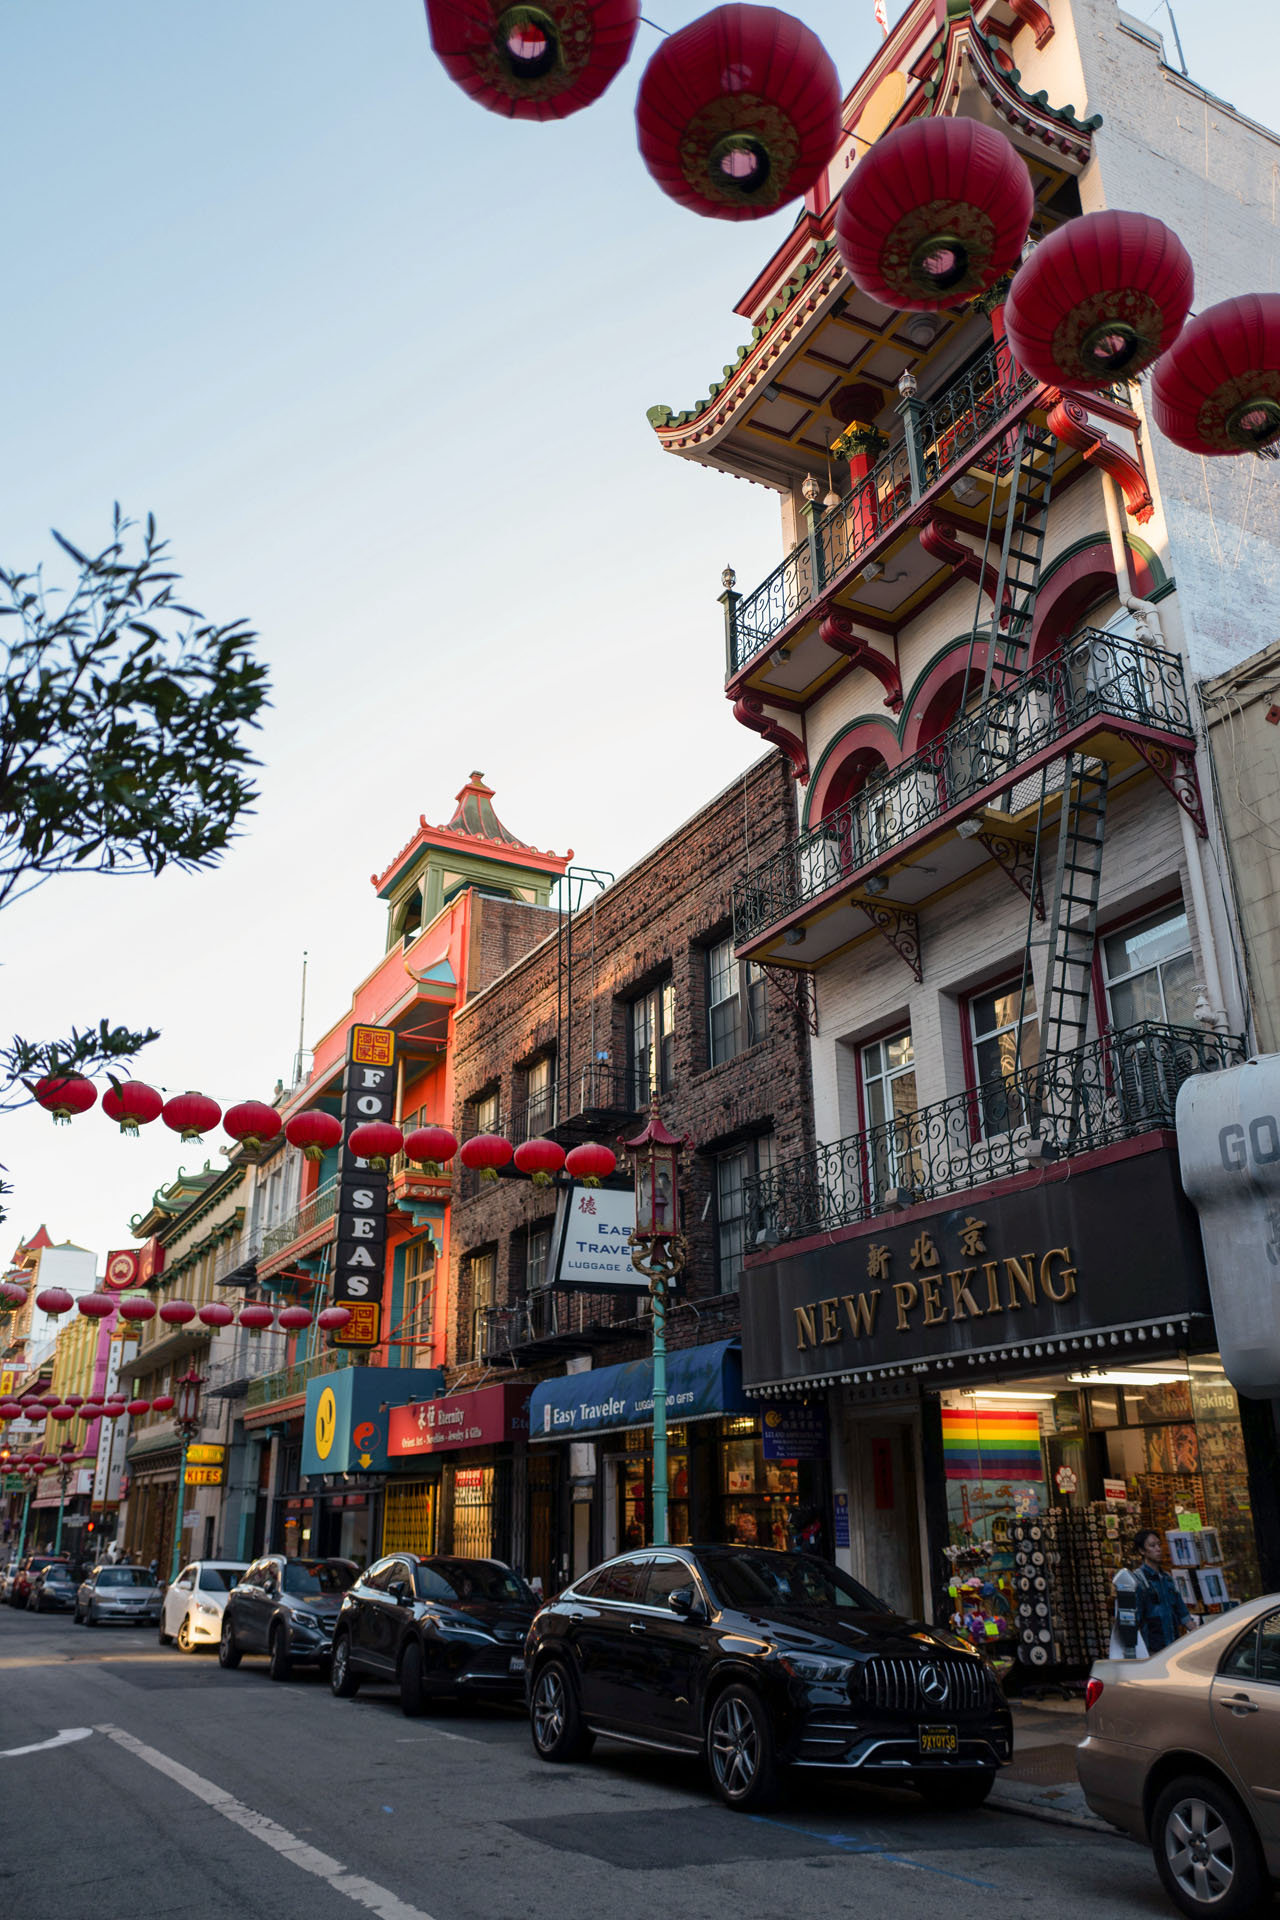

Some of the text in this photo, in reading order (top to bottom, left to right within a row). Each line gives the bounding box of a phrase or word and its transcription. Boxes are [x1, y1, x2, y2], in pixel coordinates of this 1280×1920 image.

[354, 1068, 385, 1168] FO
[578, 1195, 597, 1215] 德
[598, 1223, 635, 1236] EAS
[346, 1189, 376, 1296] SEAS
[866, 1216, 987, 1279] 新北京
[568, 1260, 621, 1272] LUGGAGE
[793, 1247, 1078, 1351] NEW PEKING
[635, 1399, 655, 1411] LUGGA
[676, 1391, 694, 1404] GIFTS
[438, 1407, 465, 1426] Eternity
[553, 1407, 577, 1426] Easy
[579, 1397, 626, 1420] Traveler
[187, 1470, 219, 1482] KITES
